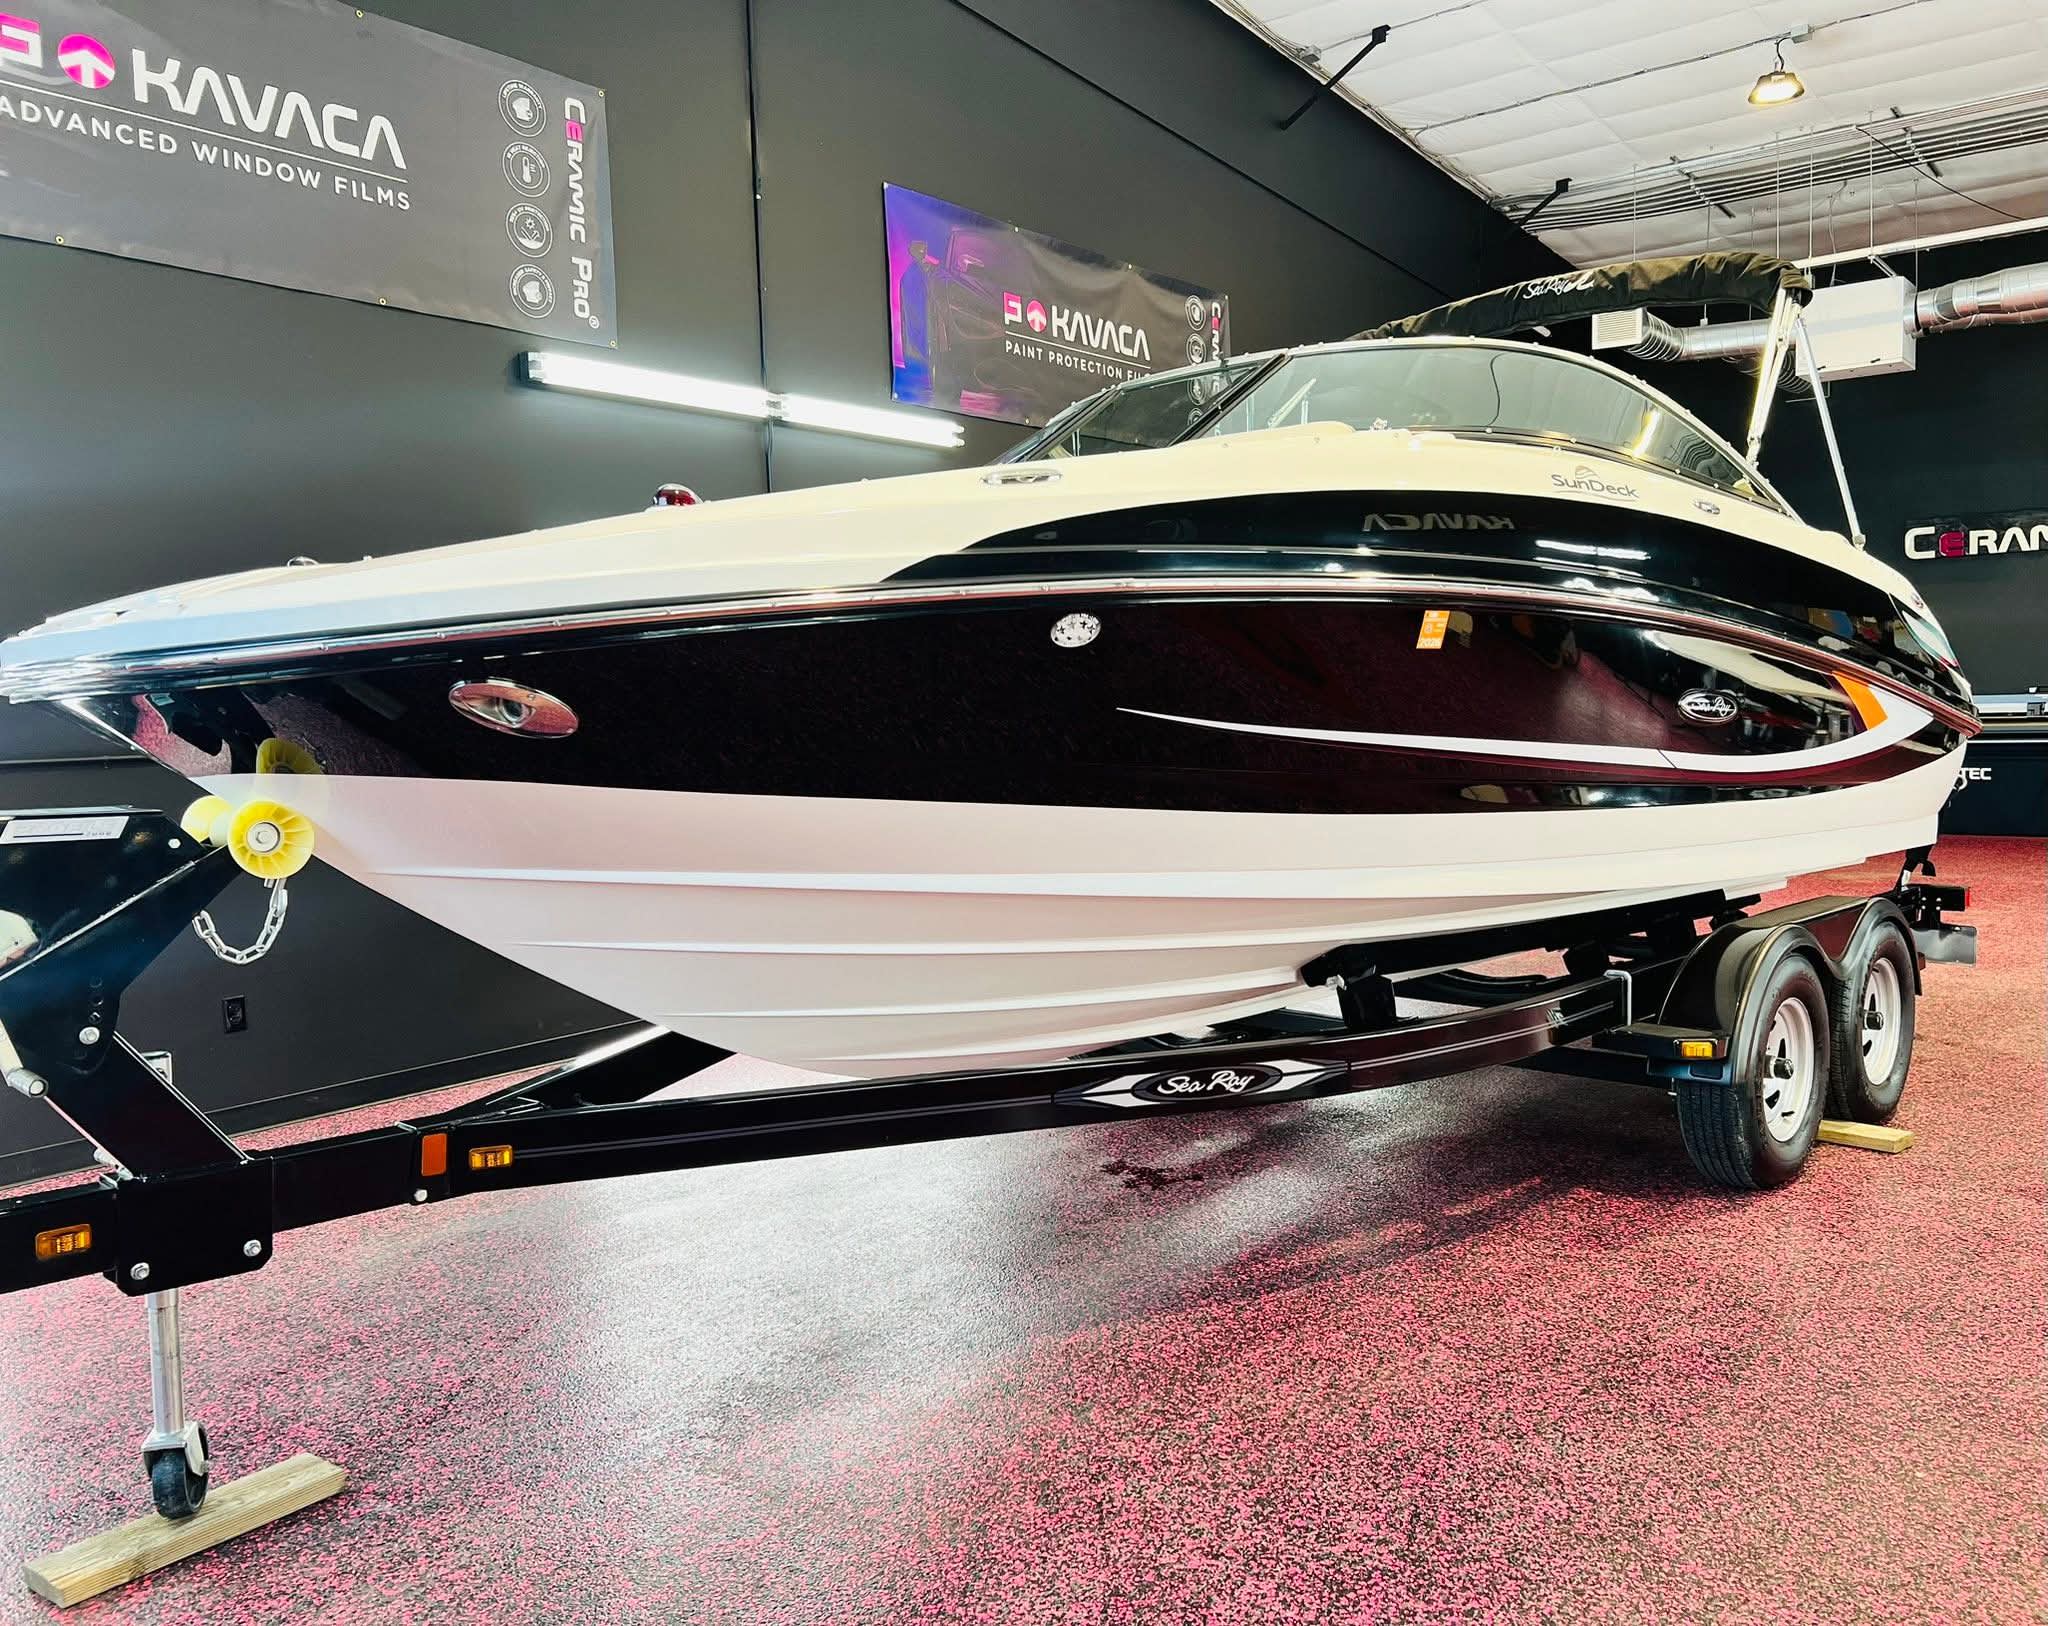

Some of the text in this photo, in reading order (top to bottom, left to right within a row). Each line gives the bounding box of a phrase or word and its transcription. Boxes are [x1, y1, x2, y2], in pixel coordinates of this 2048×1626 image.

[132, 48, 407, 170] KAVACA
[0, 95, 410, 210] ADVANCED WINDOW FILMS
[564, 97, 587, 244] CERAMIC
[1005, 340, 1043, 361] PAINT
[1048, 350, 1122, 380] PROTECTION
[1051, 304, 1151, 361] KAVACA
[1551, 474, 1640, 498] SunDeck
[1157, 1070, 1255, 1094] Sea Ray
